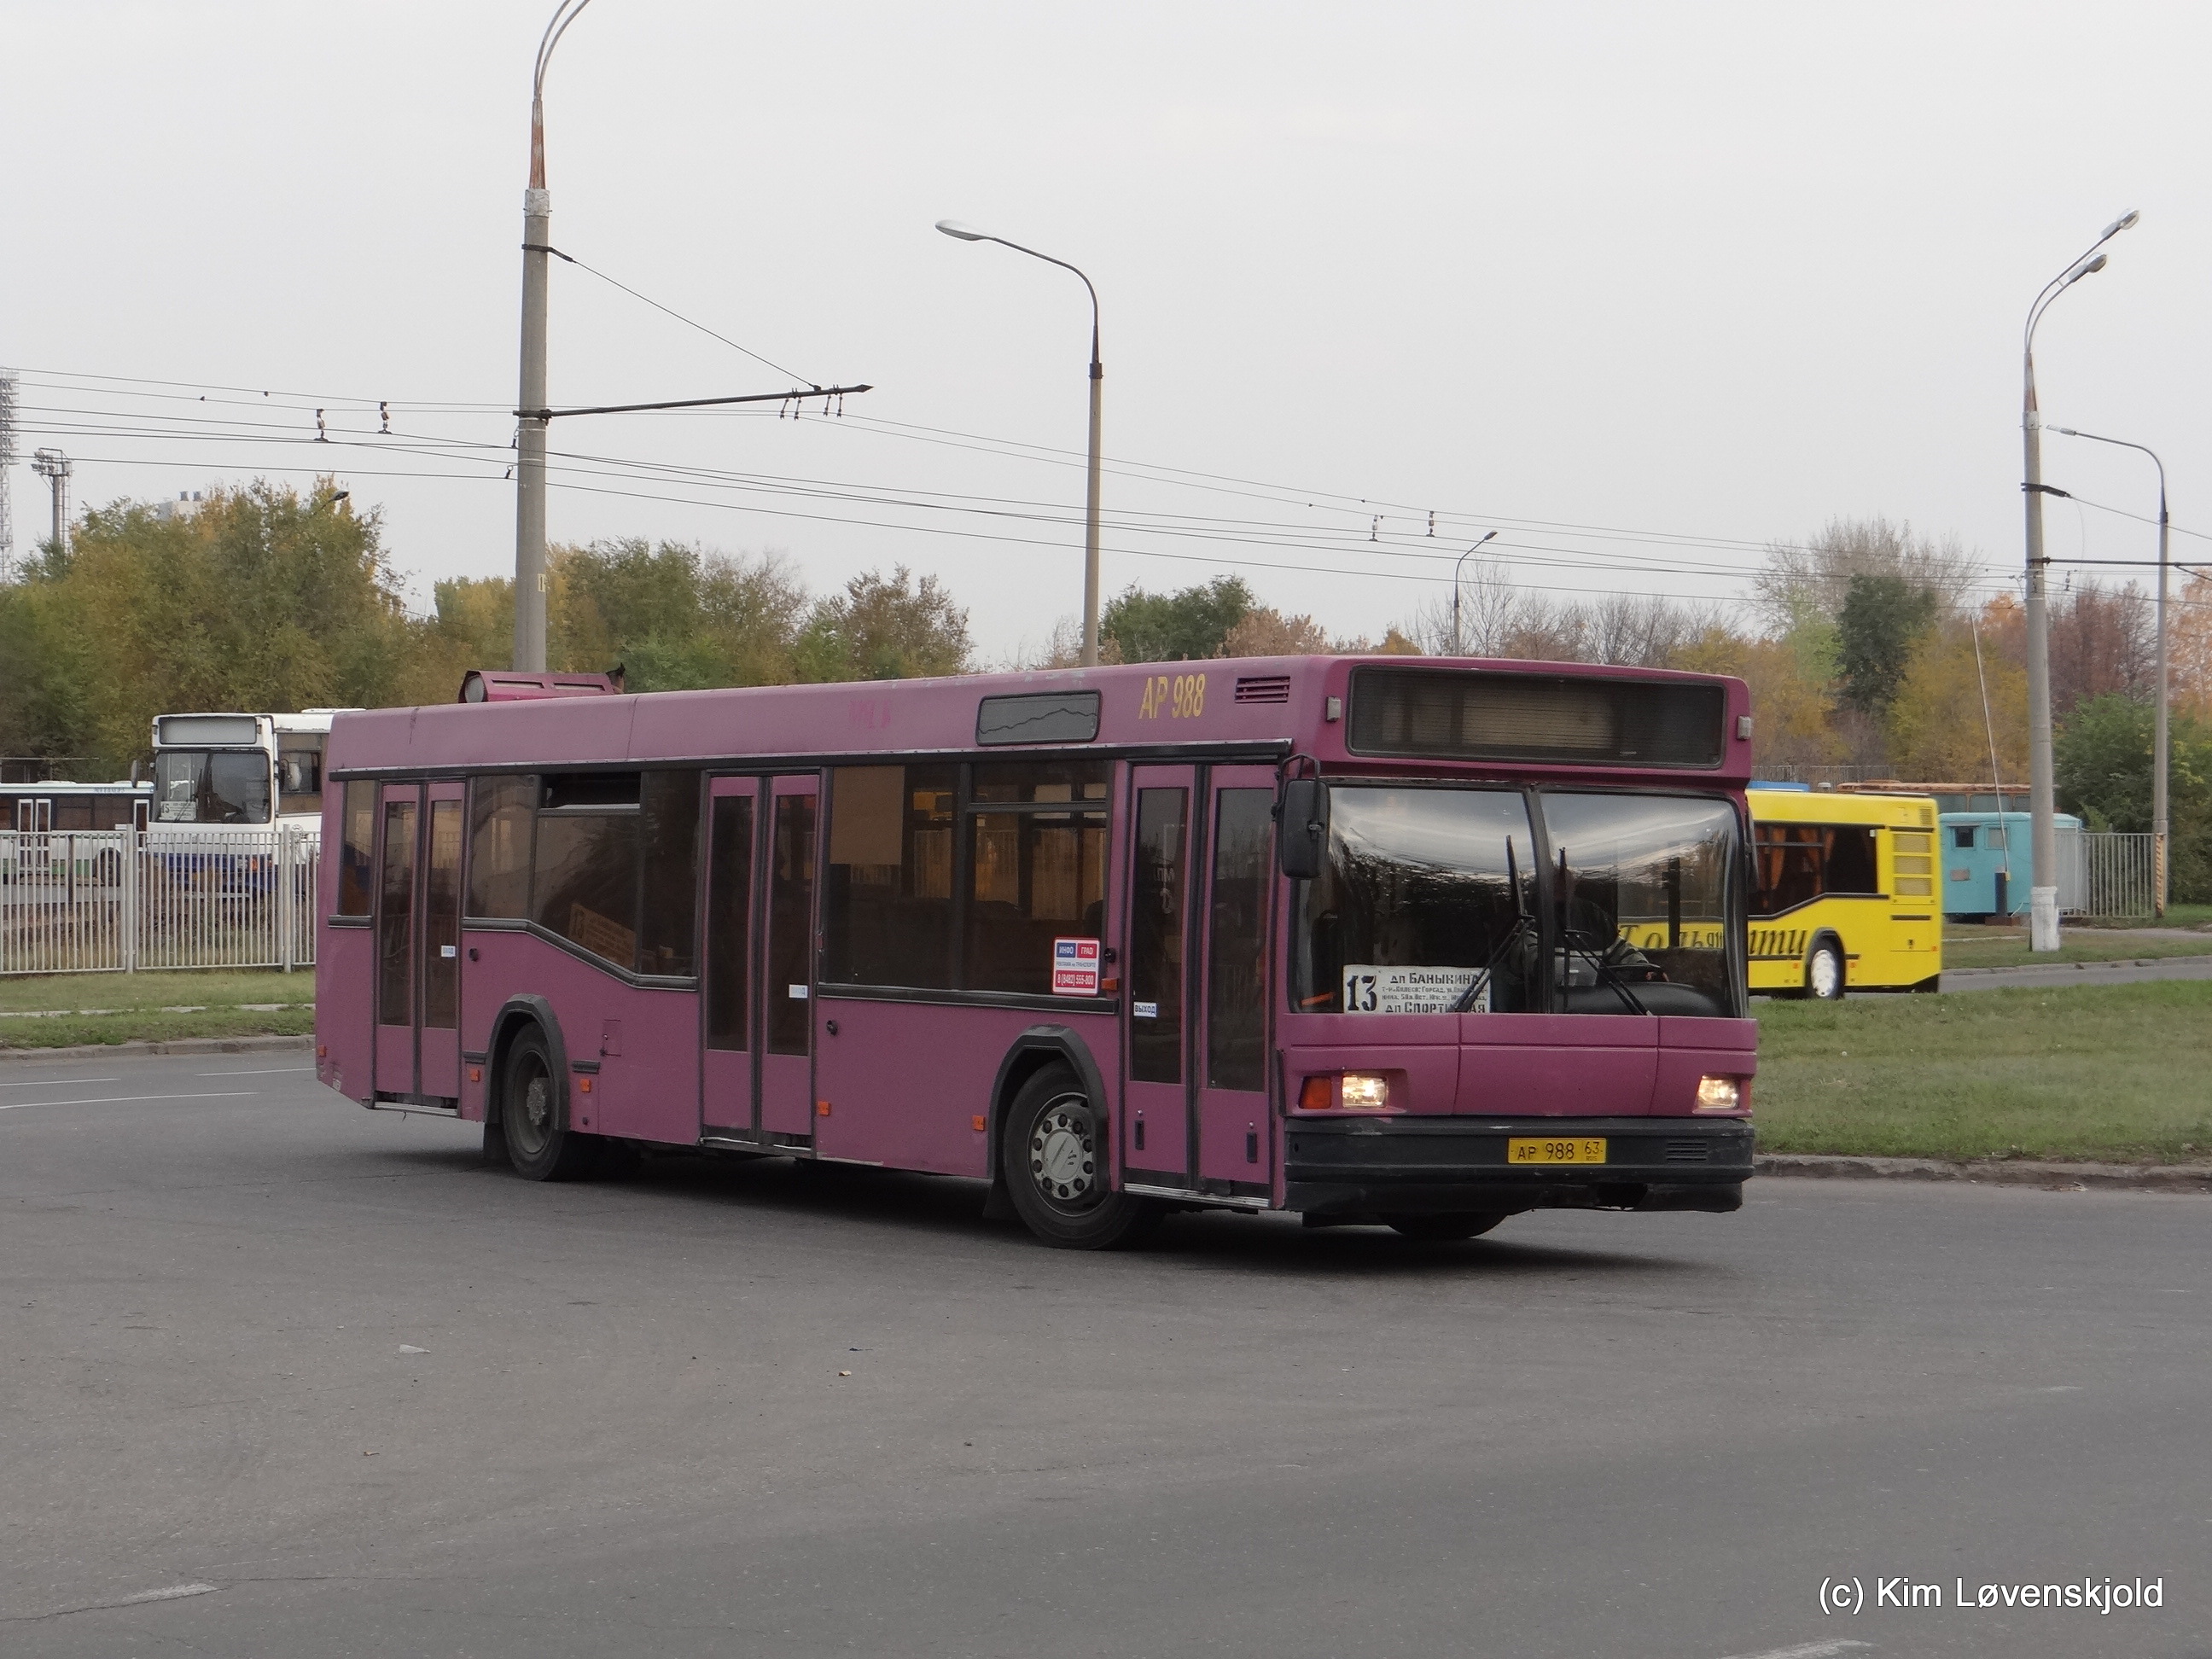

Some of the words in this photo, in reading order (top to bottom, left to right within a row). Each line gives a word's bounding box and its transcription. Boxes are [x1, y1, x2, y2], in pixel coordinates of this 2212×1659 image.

[1138, 676, 1168, 719] АР
[1172, 673, 1206, 718] 988
[1080, 946, 1093, 955] ГРАД
[1347, 975, 1377, 1011] 13
[1135, 1004, 1155, 1014] ВЫХОД
[1518, 1146, 1536, 1160] АР
[1545, 1143, 1575, 1160] 988
[1585, 1141, 1600, 1154] 63
